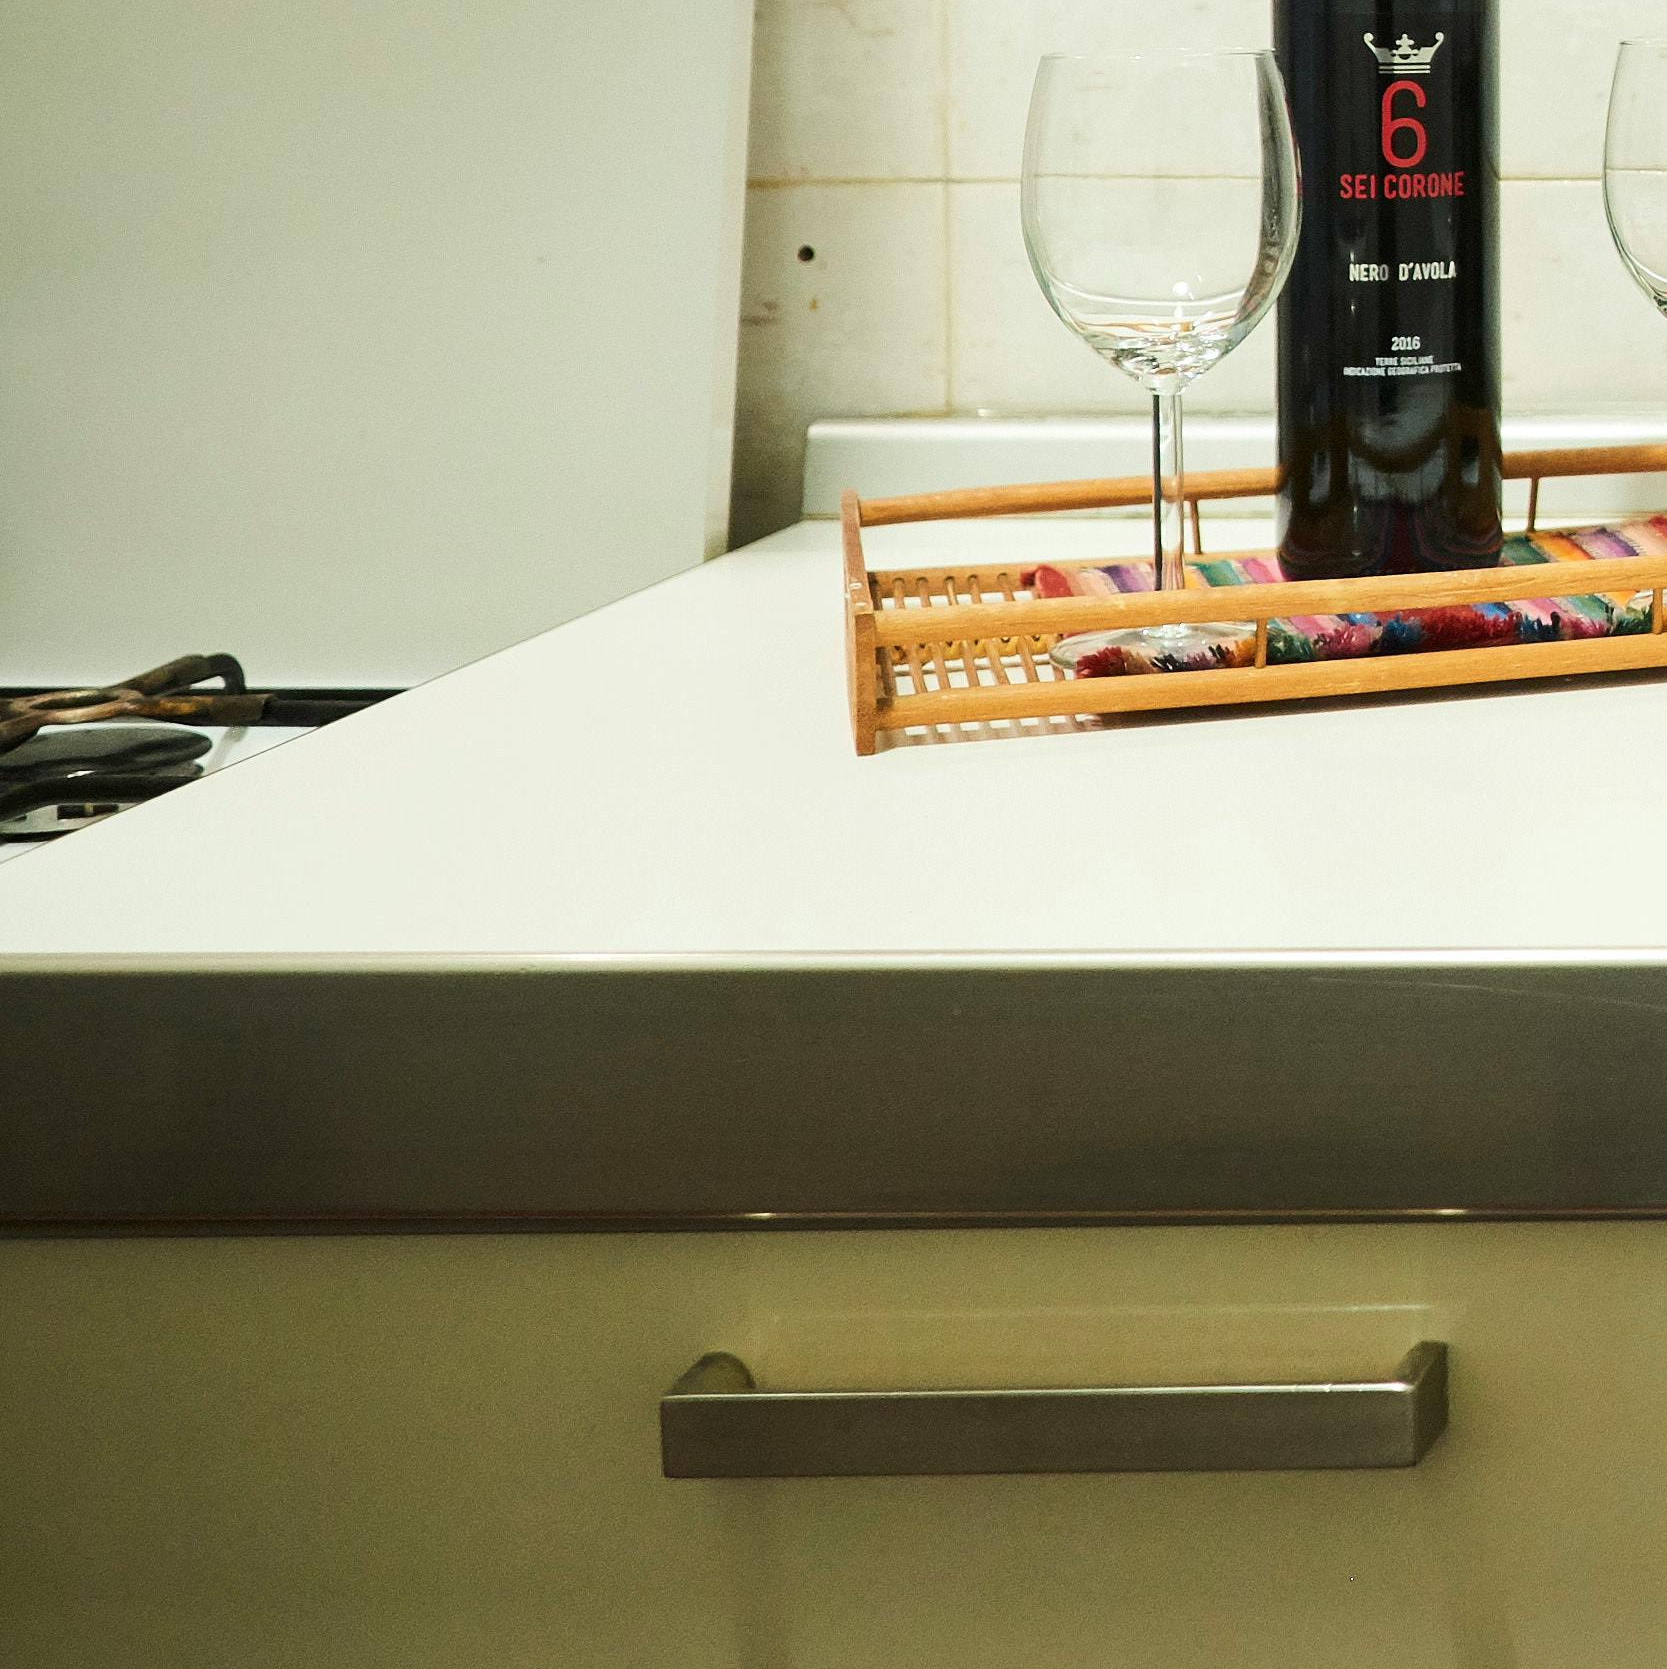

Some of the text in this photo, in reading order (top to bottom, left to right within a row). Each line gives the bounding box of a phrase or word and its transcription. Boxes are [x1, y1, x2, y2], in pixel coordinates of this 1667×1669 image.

[1381, 79, 1427, 168] 6
[1340, 171, 1465, 199] SEI CORONE
[1349, 261, 1457, 281] NERO D'AVOLA
[1391, 336, 1421, 351] 2016
